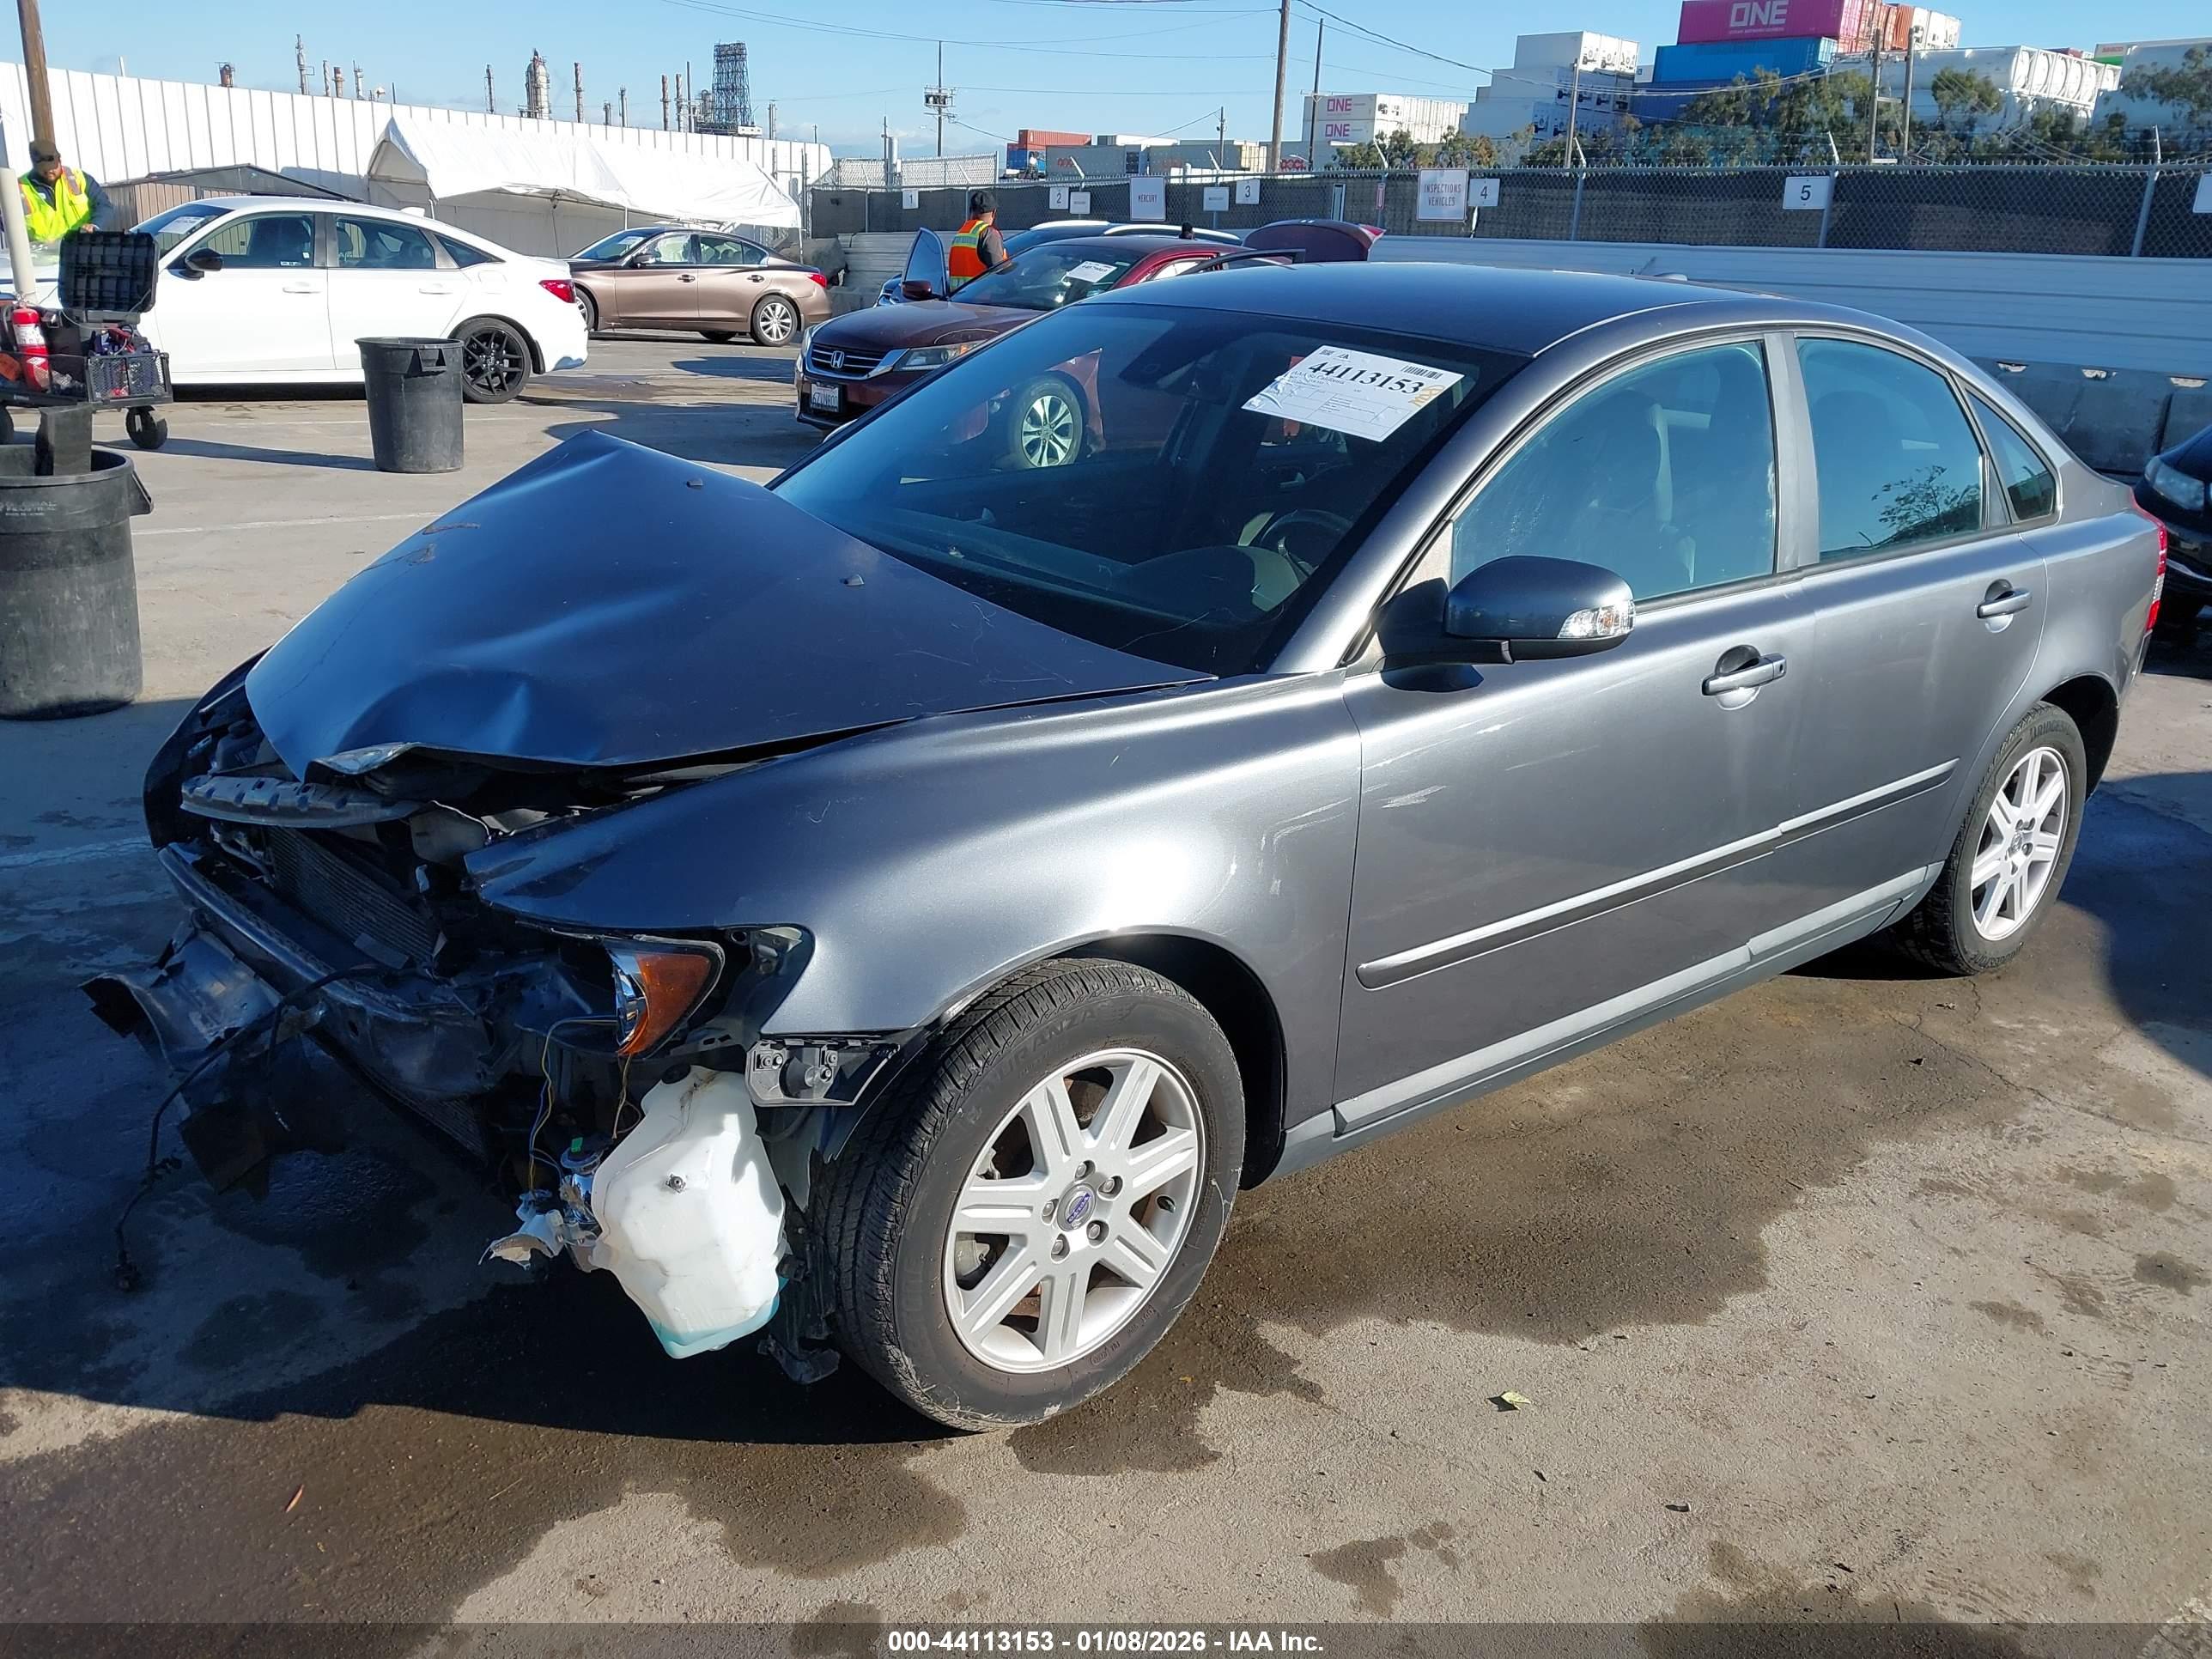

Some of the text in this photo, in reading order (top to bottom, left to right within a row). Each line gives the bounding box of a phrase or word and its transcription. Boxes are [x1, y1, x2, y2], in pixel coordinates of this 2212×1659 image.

[1729, 0, 1789, 27] ONE
[1327, 98, 1352, 112] ONE
[1325, 124, 1350, 137] ONE
[1244, 185, 1251, 198] 3
[1424, 183, 1462, 193] INSPECTIONS
[1480, 185, 1488, 199] 4
[1800, 185, 1811, 200] 5
[1056, 191, 1062, 204] 2
[1138, 194, 1157, 203] MERCURY
[1428, 196, 1455, 206] VEHICLES
[1308, 362, 1425, 394] 44113153
